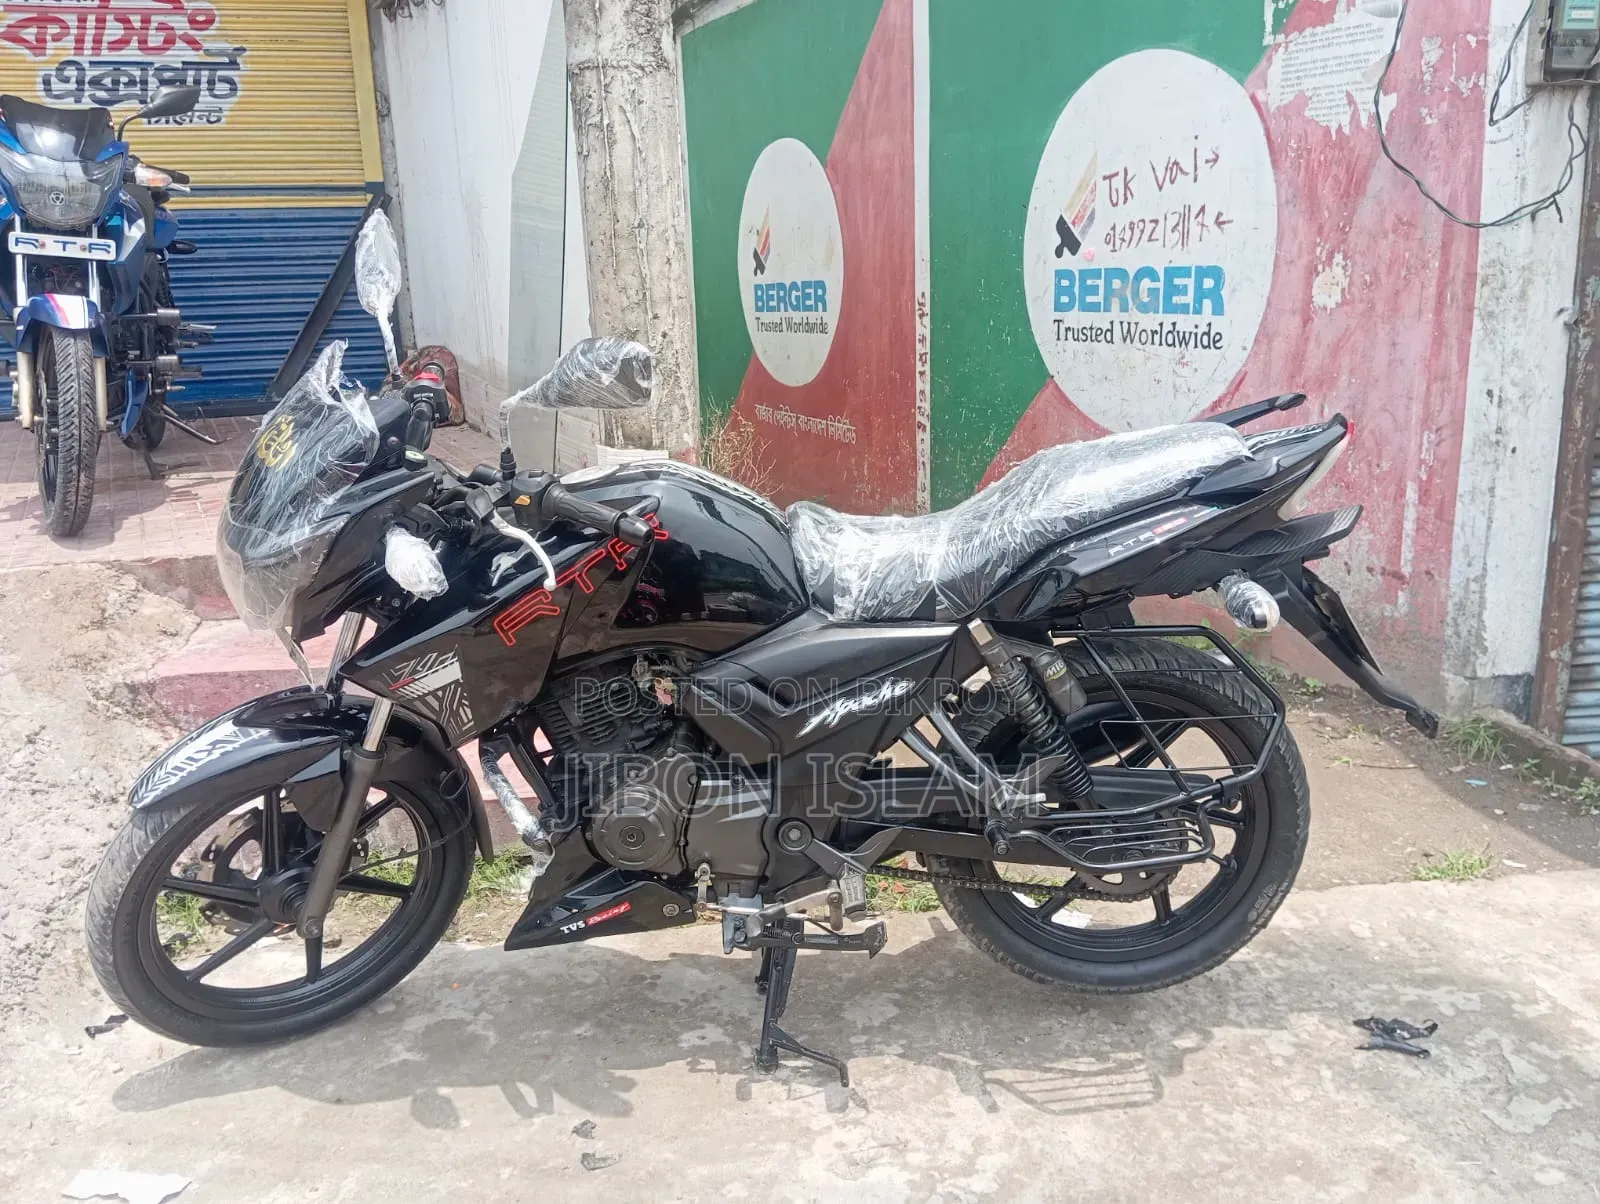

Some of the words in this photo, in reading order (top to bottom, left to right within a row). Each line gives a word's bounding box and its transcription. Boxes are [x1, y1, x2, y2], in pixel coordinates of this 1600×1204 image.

[753, 279, 828, 313] BERGER
[1053, 265, 1226, 317] BERGER
[755, 316, 784, 334] Trusted
[784, 316, 829, 335] Worldwide
[1053, 319, 1114, 345] Trusted
[1119, 321, 1224, 350] Worldwide
[795, 676, 916, 739] Apache
[560, 920, 586, 935] TVS
